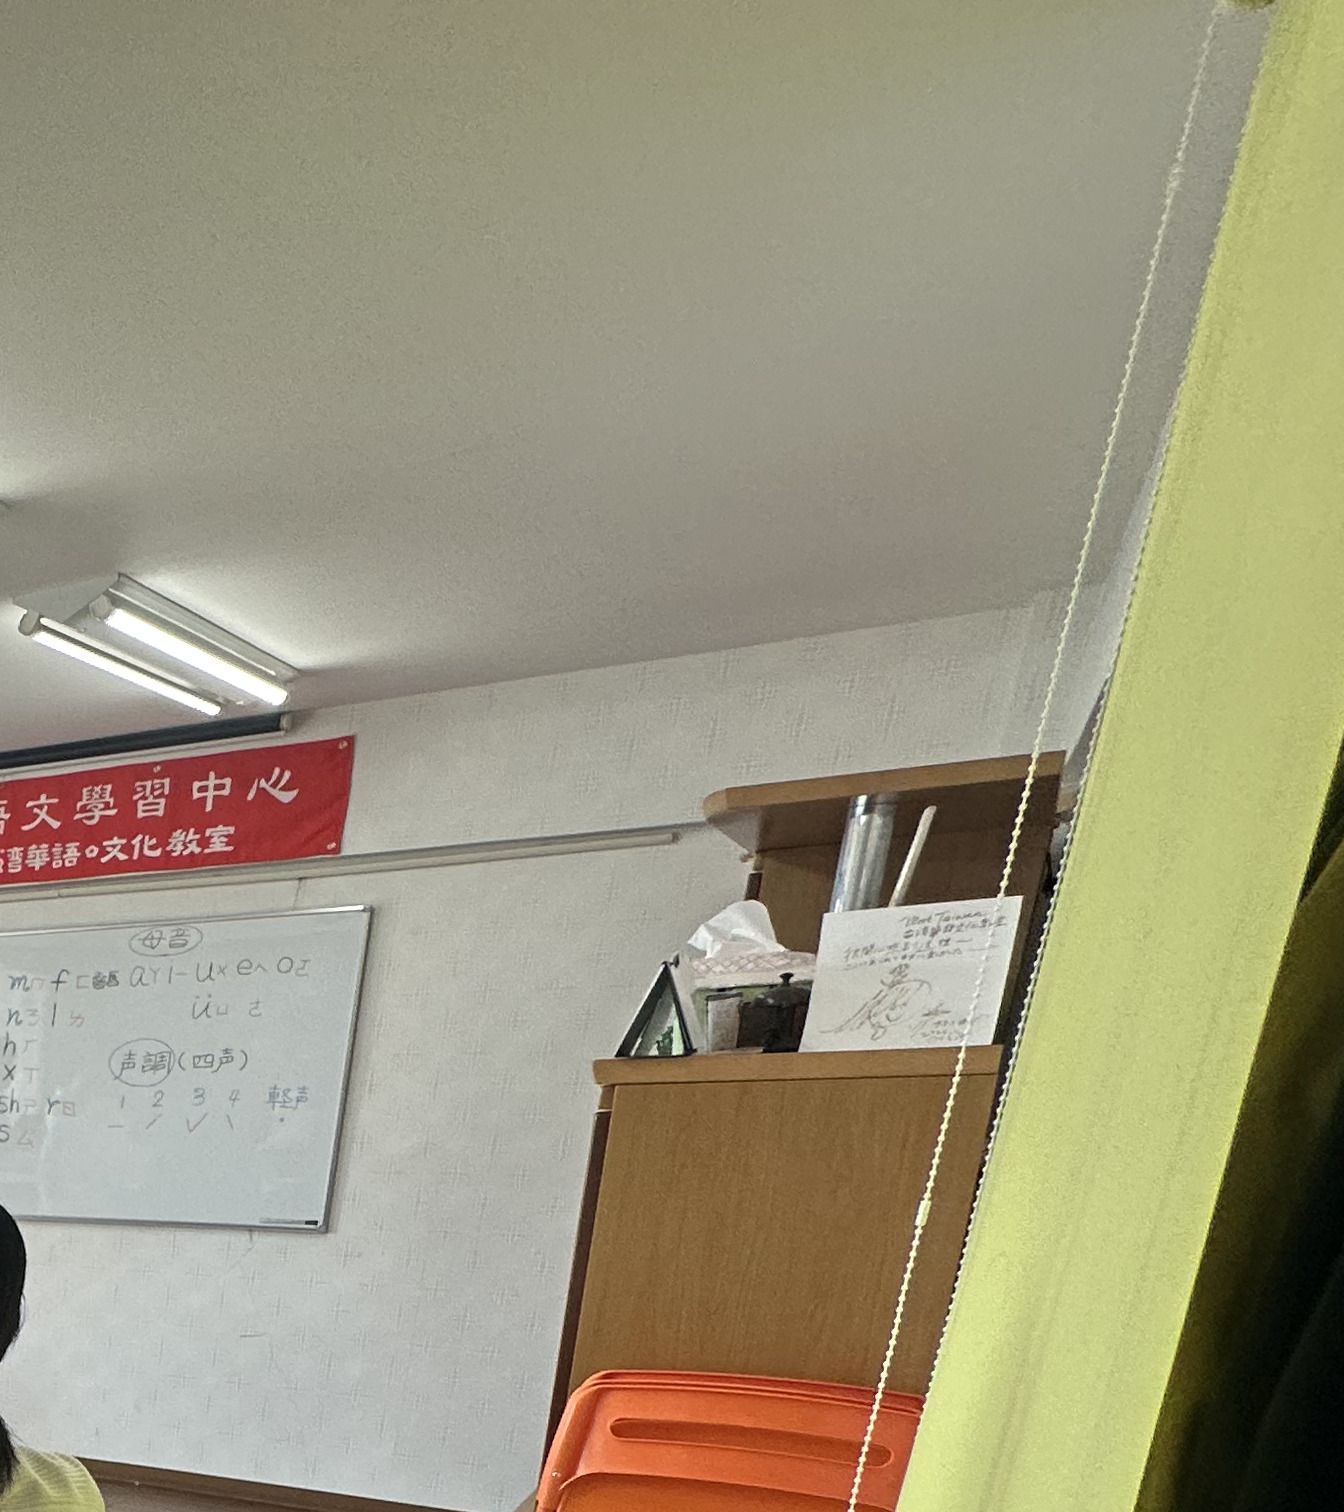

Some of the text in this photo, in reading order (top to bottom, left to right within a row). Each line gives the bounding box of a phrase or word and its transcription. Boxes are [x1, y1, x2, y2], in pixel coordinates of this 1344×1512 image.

[138, 928, 191, 949] 母音
[152, 1089, 165, 1108] 2
[192, 1087, 206, 1107] 3
